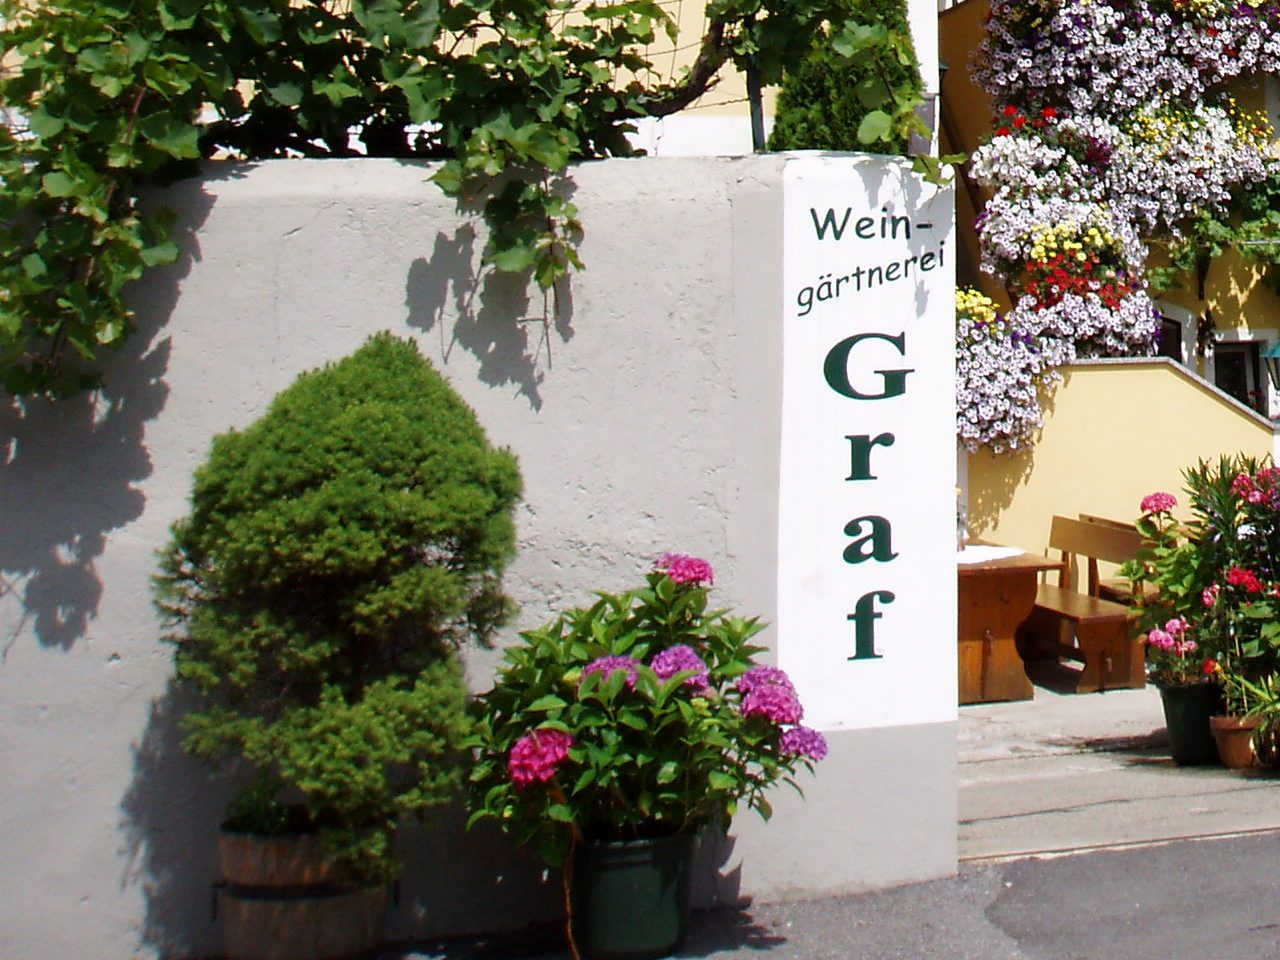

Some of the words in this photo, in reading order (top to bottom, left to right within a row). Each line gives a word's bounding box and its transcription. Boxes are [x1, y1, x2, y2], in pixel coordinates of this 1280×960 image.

[810, 206, 934, 241] Wein-
[796, 240, 946, 317] gärtnerei
[823, 330, 916, 661] Graf
